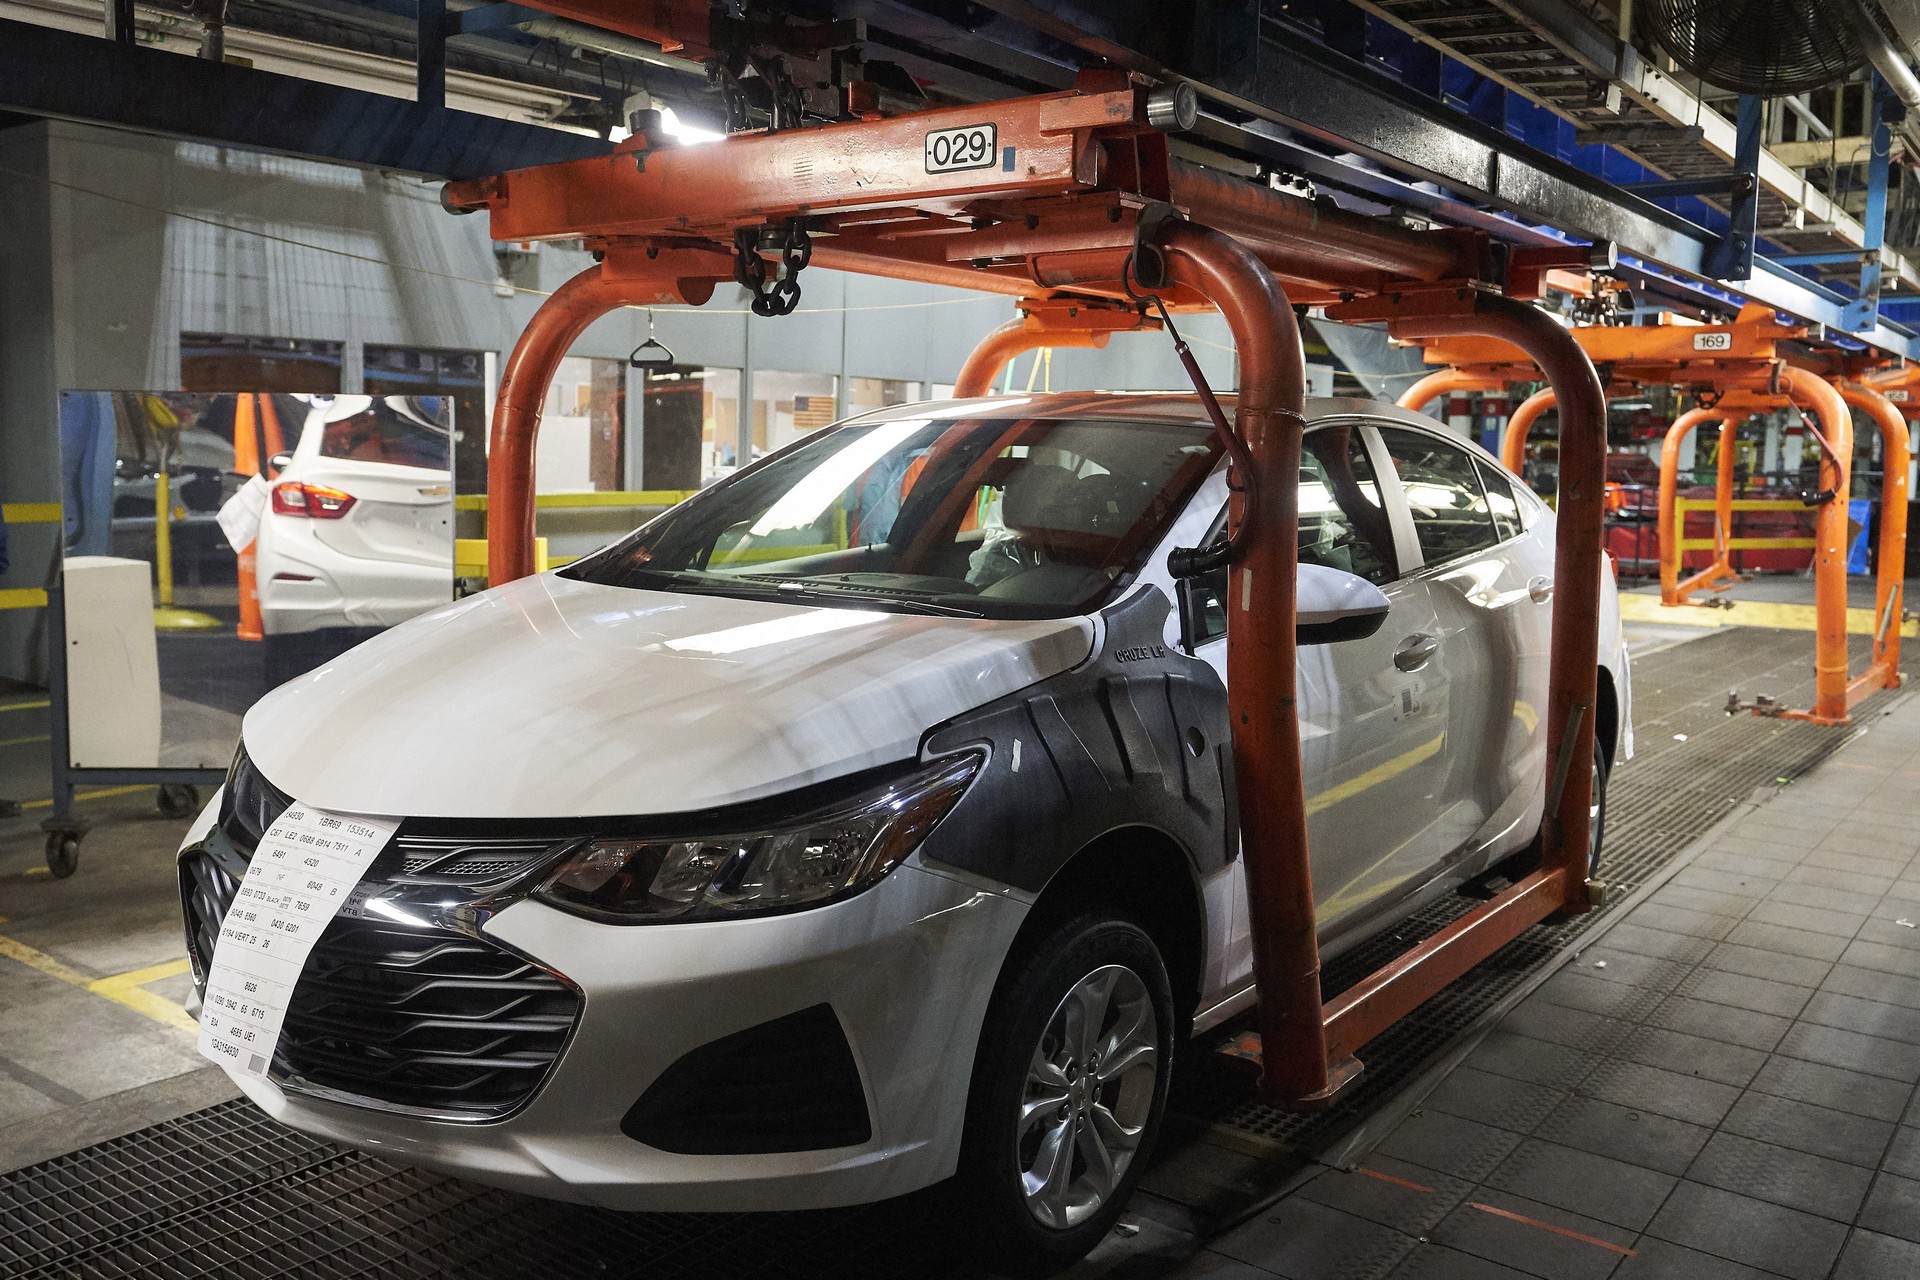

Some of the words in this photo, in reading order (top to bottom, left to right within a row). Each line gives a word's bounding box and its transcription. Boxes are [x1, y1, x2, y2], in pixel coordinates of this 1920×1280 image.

[933, 131, 986, 166] 029
[1700, 335, 1725, 348] 169
[1114, 646, 1151, 663] CRUZE
[1151, 644, 1166, 658] LH
[318, 817, 342, 830] 1BR69
[346, 824, 375, 838] 153514
[285, 831, 298, 840] LE2
[316, 838, 332, 848] 6914
[332, 842, 350, 852] 7511
[354, 848, 362, 856] A
[304, 858, 320, 868] 4520
[330, 888, 338, 896] B
[266, 894, 280, 904] BLACK
[294, 900, 311, 912] 7659
[285, 922, 300, 934] 6201
[234, 930, 250, 942] VERT
[249, 936, 257, 945] 25
[262, 939, 270, 948] 26
[240, 1004, 248, 1014] 65
[252, 1008, 265, 1020] 6715
[244, 1031, 256, 1042] UE1
